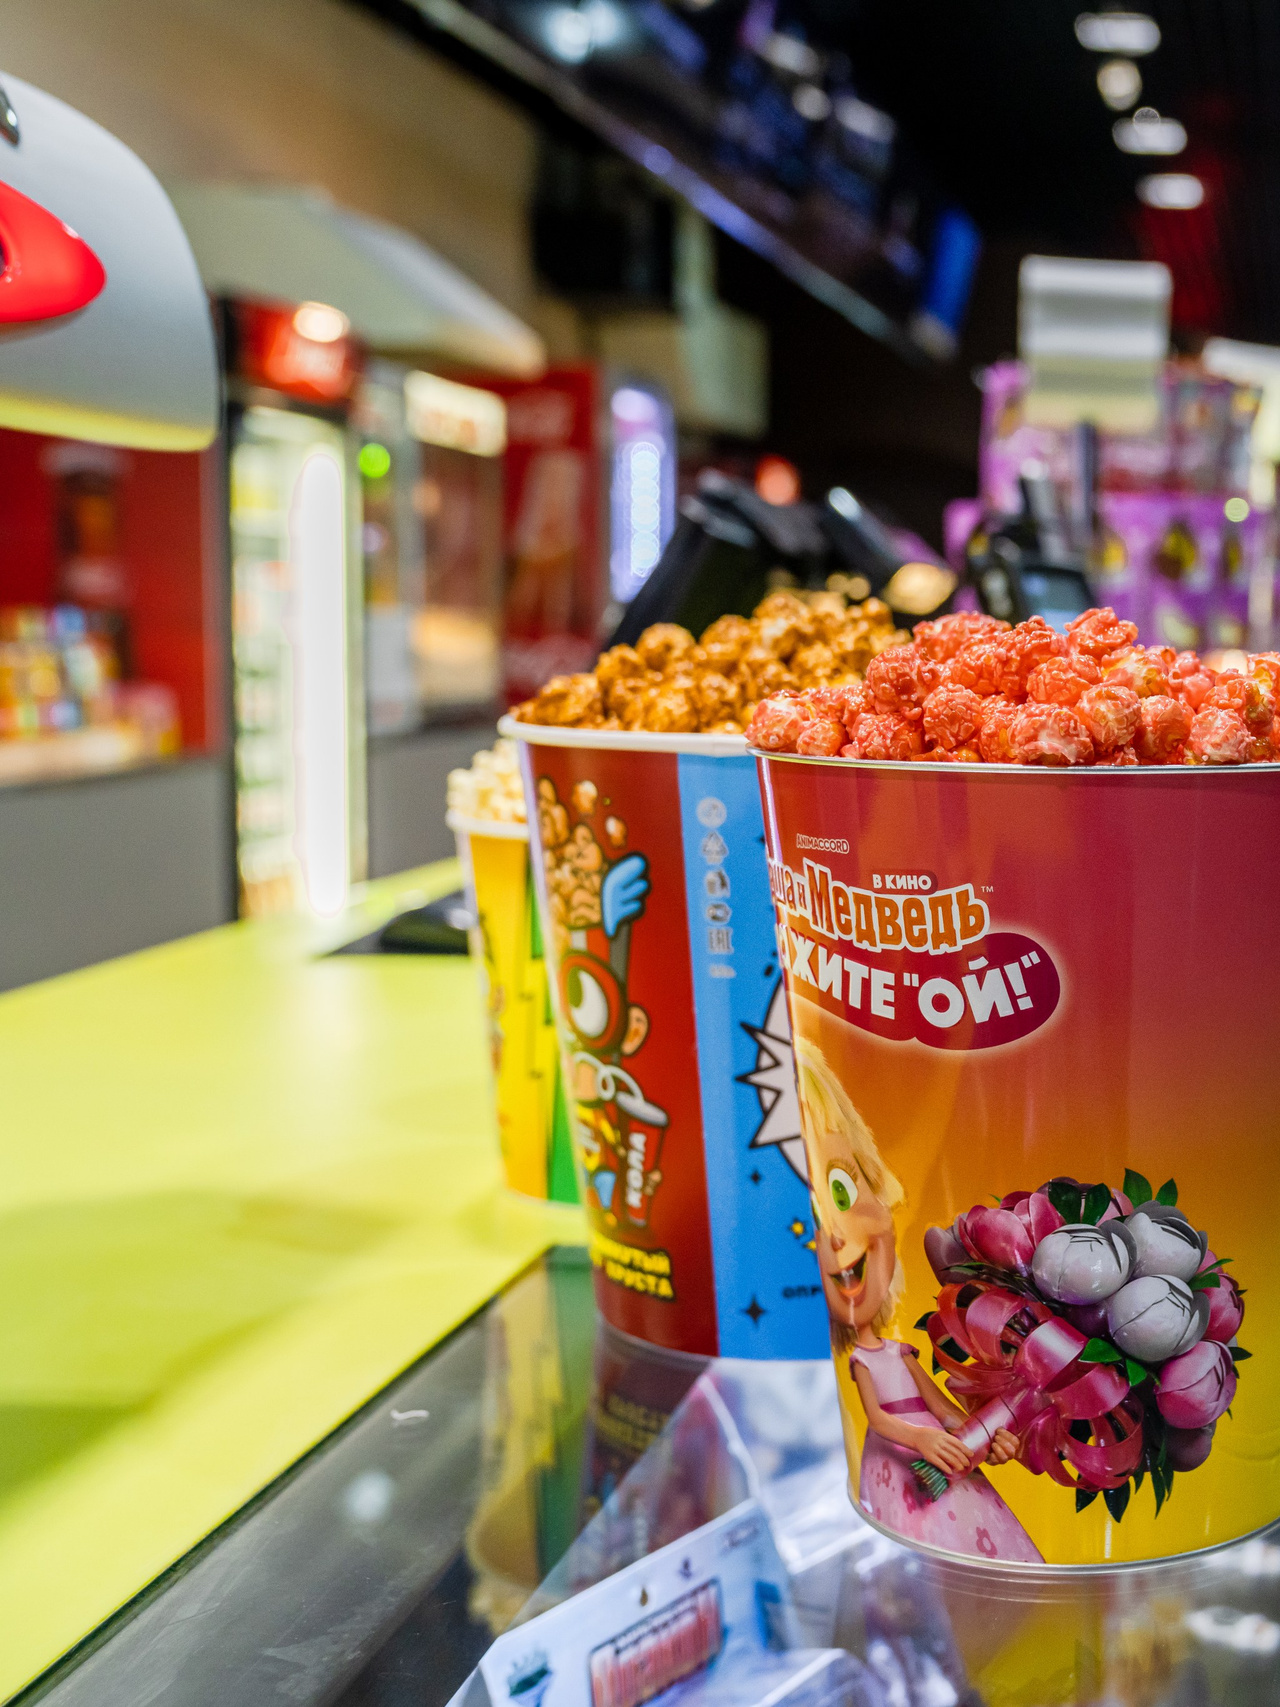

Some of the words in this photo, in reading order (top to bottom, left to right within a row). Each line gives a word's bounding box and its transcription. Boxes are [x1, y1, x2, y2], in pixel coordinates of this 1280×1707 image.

[796, 833, 850, 854] ANIMACCORD
[873, 874, 883, 889] В
[885, 874, 932, 891] КИНО
[803, 857, 989, 955] Медведь
